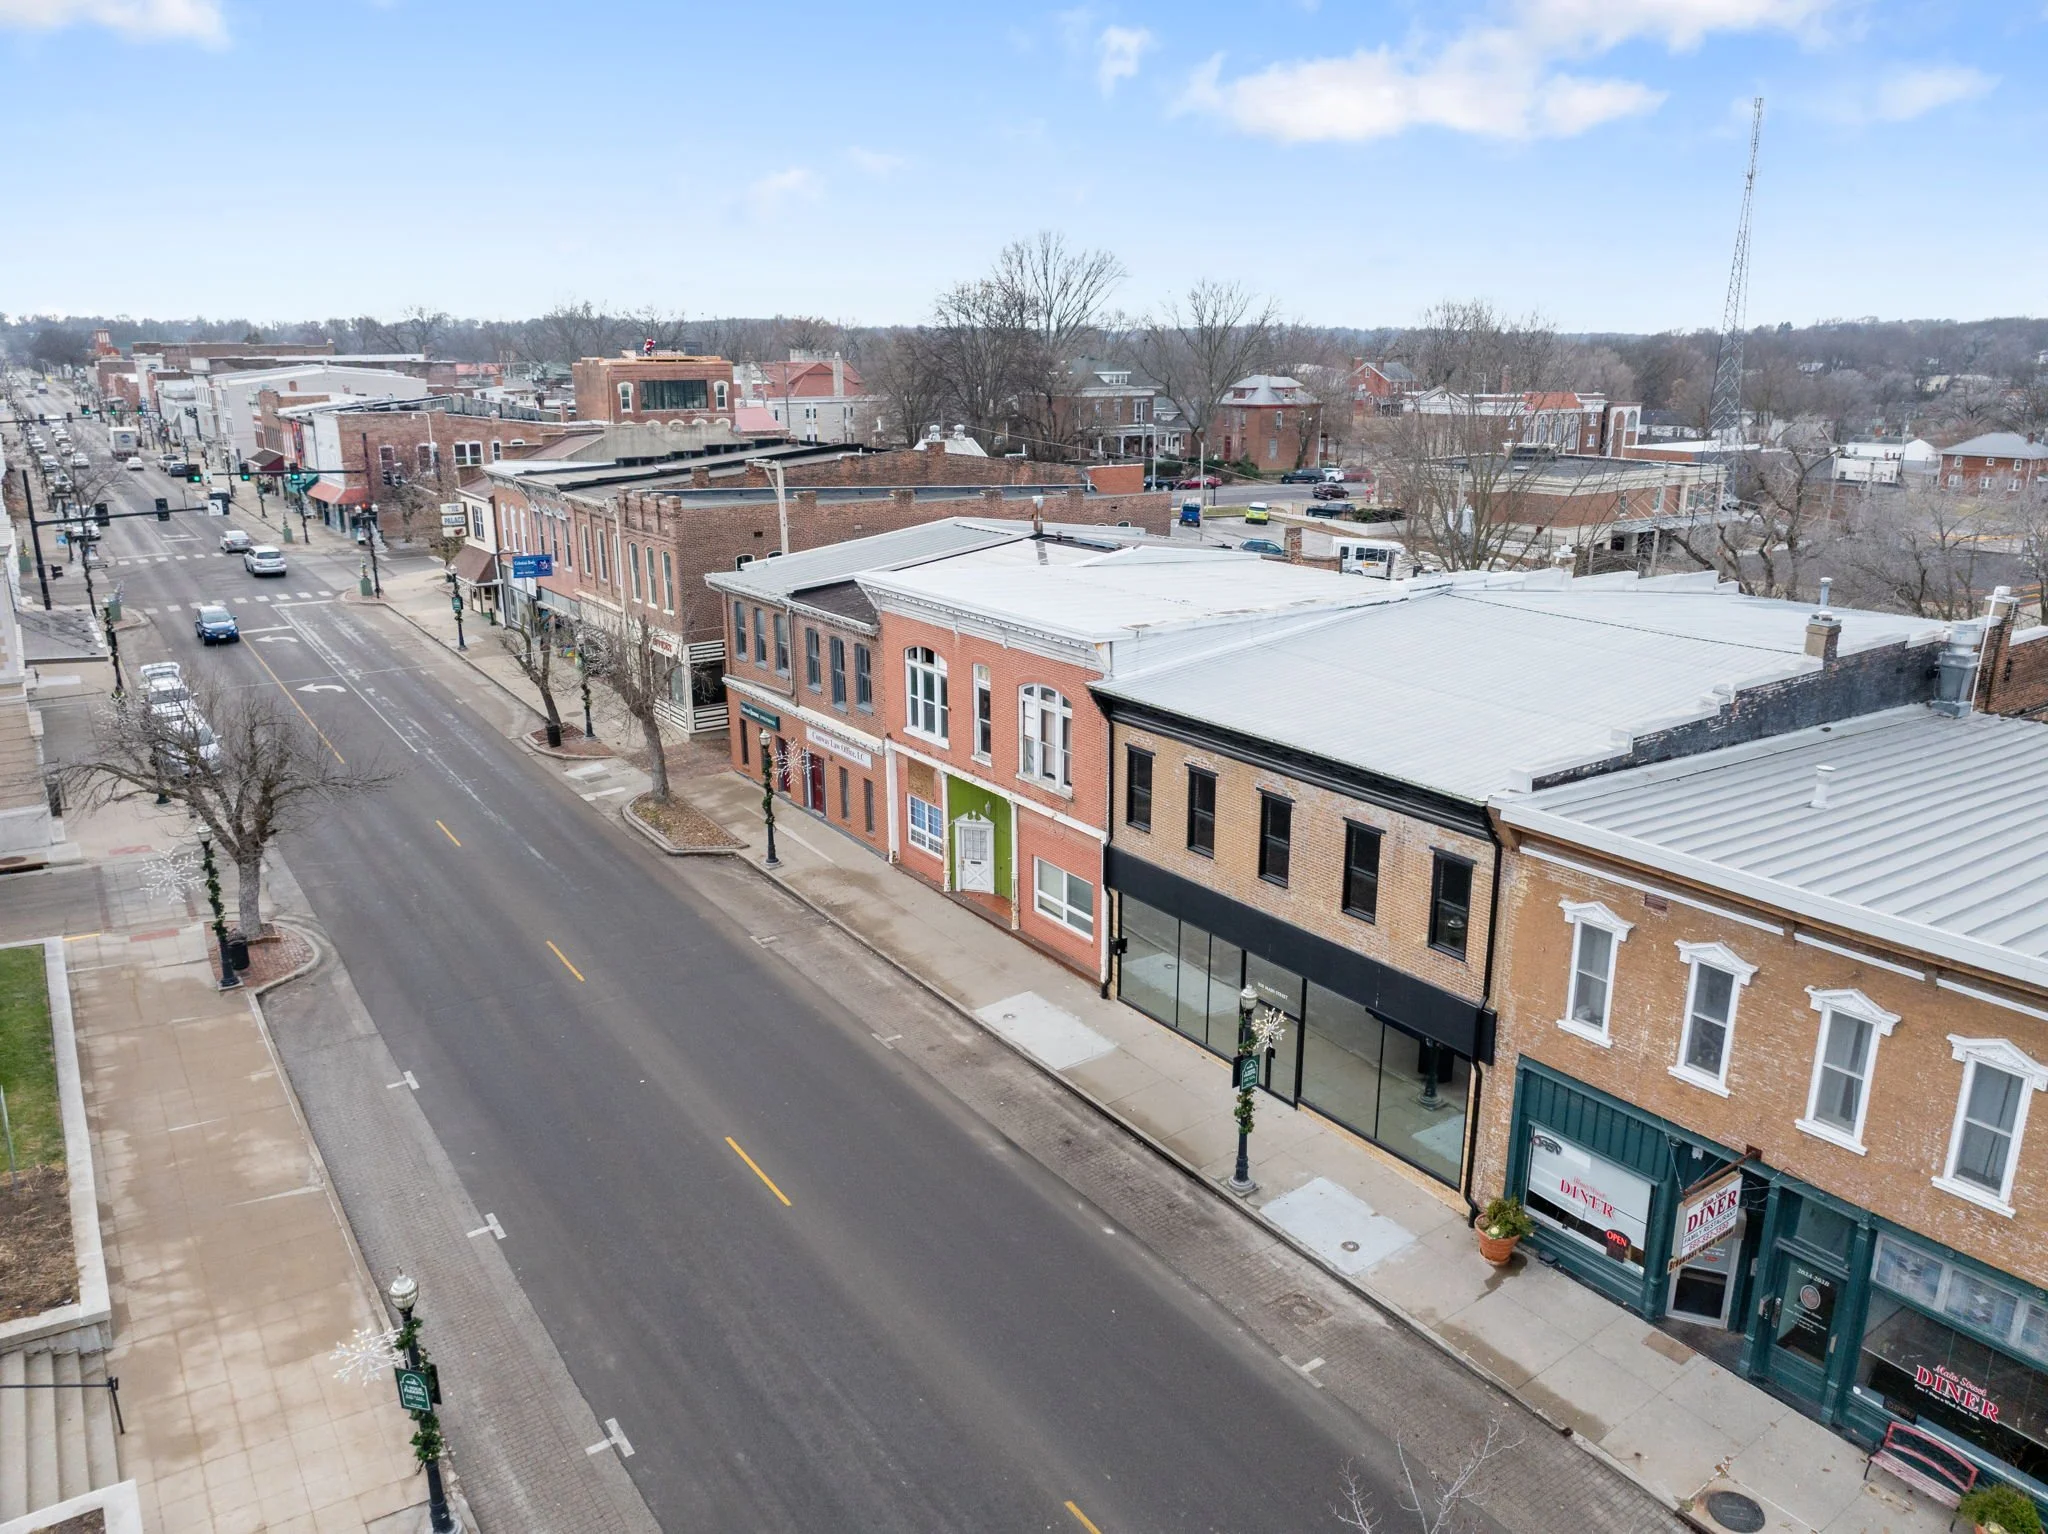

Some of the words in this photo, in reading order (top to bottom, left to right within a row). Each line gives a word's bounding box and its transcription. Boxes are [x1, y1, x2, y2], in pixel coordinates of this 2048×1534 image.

[444, 516, 464, 524] PALACE
[830, 739, 841, 749] Law
[1532, 1135, 1561, 1155] OPEN
[1560, 1178, 1616, 1221] DINER
[1687, 1190, 1737, 1233] DINER
[1606, 1230, 1627, 1247] OPEN
[1683, 1229, 1702, 1244] FAMILY
[1703, 1209, 1736, 1232] RESTAURANT
[1914, 1364, 1999, 1424] DINER
[1933, 1364, 1959, 1383] Main
[1959, 1377, 1988, 1397] Street
